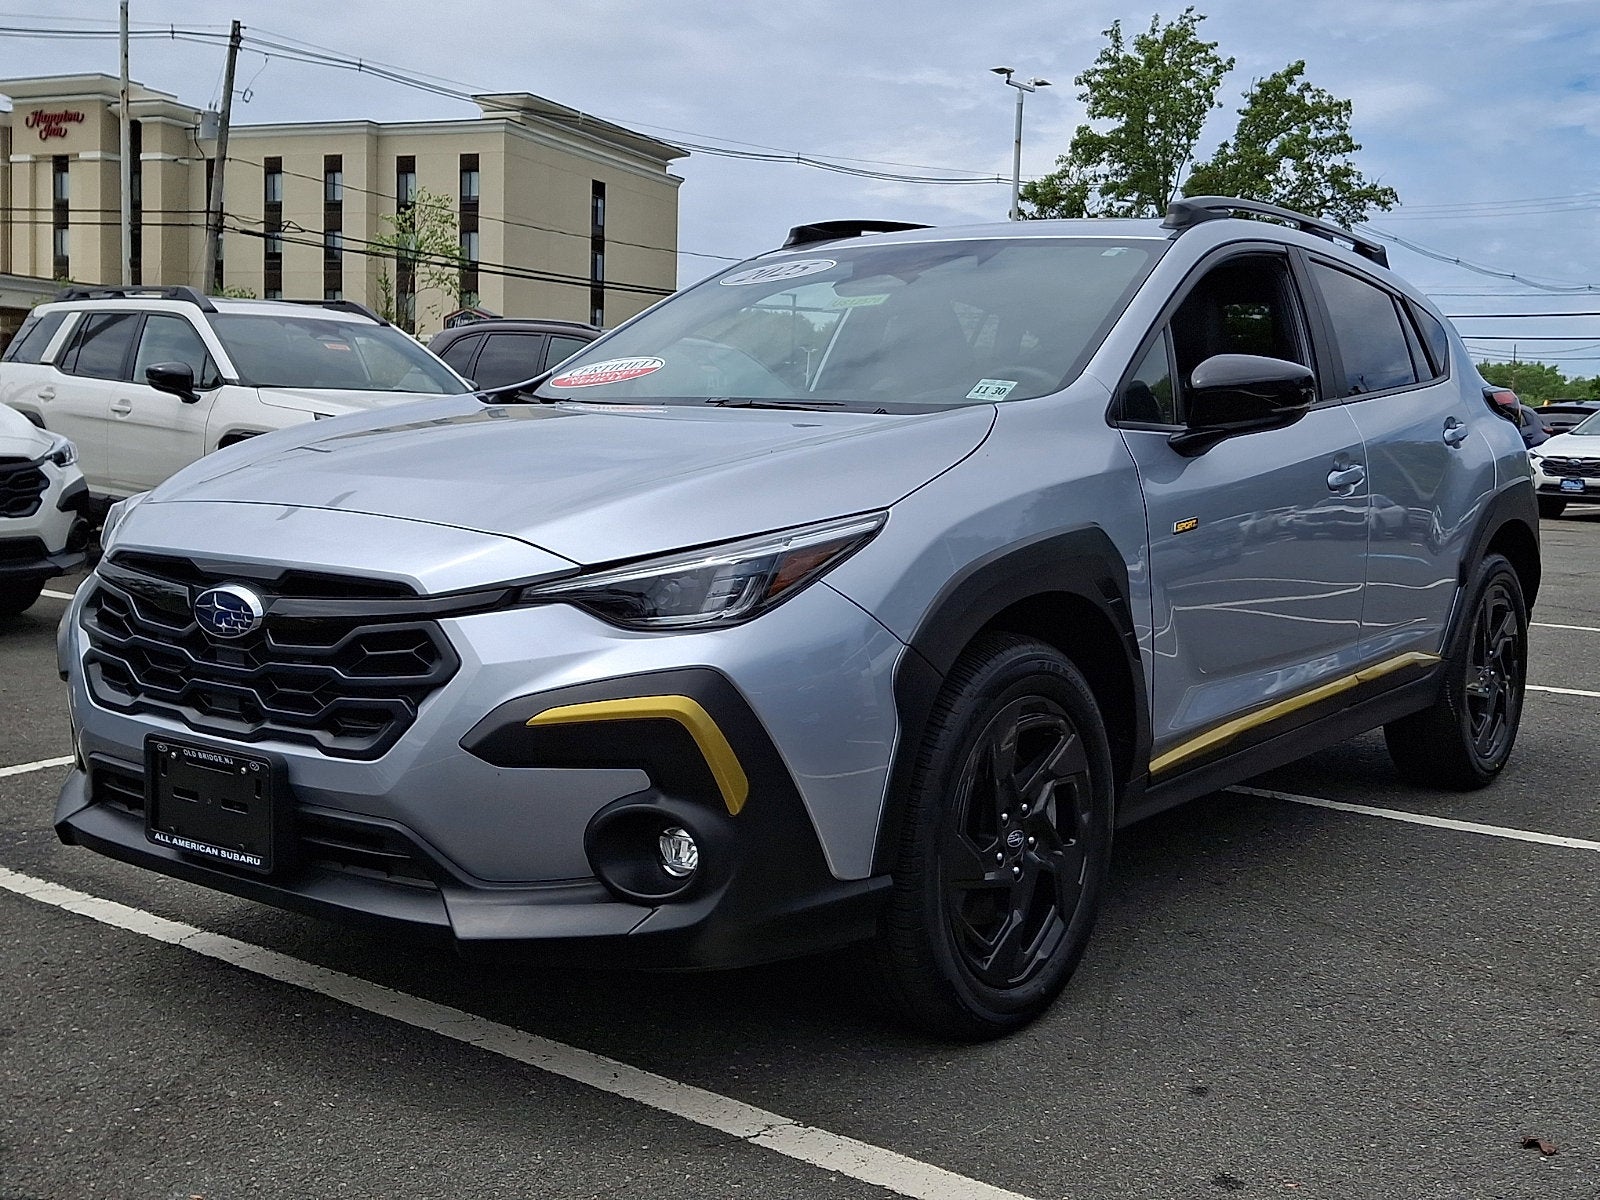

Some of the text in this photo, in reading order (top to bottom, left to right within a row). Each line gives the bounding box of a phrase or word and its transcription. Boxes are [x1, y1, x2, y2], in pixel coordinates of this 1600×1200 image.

[25, 109, 85, 128] Hampton
[39, 124, 68, 141] Inn
[569, 359, 657, 377] CERTIFIED
[974, 385, 990, 394] 11
[991, 386, 1007, 396] 30
[182, 748, 197, 758] OLD
[154, 832, 261, 866] ALL AMERICAN SUBARU
